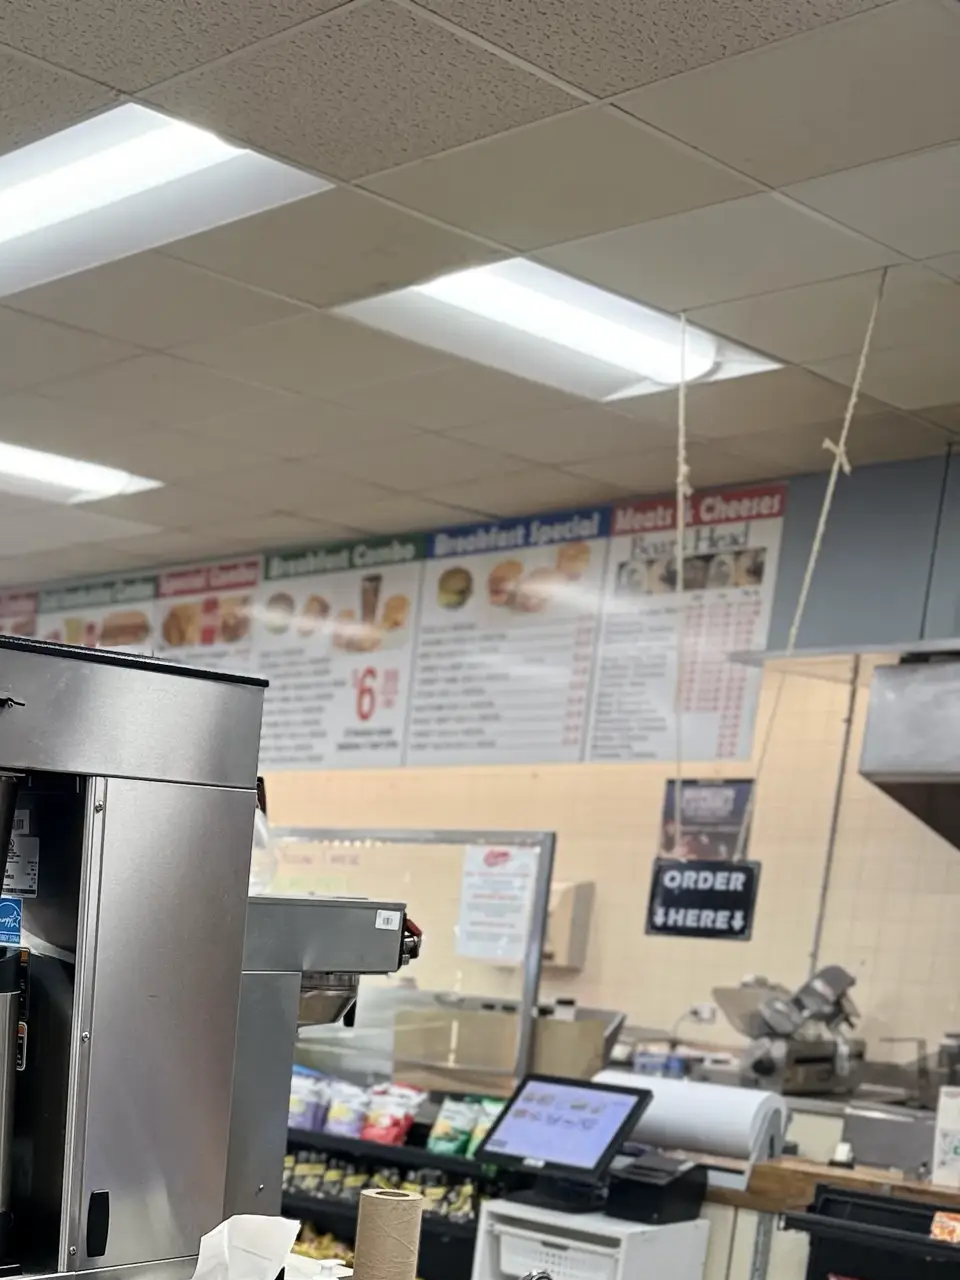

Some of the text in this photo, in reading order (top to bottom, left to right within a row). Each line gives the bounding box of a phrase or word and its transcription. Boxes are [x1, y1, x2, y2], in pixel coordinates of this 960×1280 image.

[615, 506, 672, 531] Meats
[700, 492, 782, 522] Cheeses
[435, 512, 601, 557] Breakfast Special
[663, 870, 746, 891] ORDER
[666, 908, 732, 930] HERE
